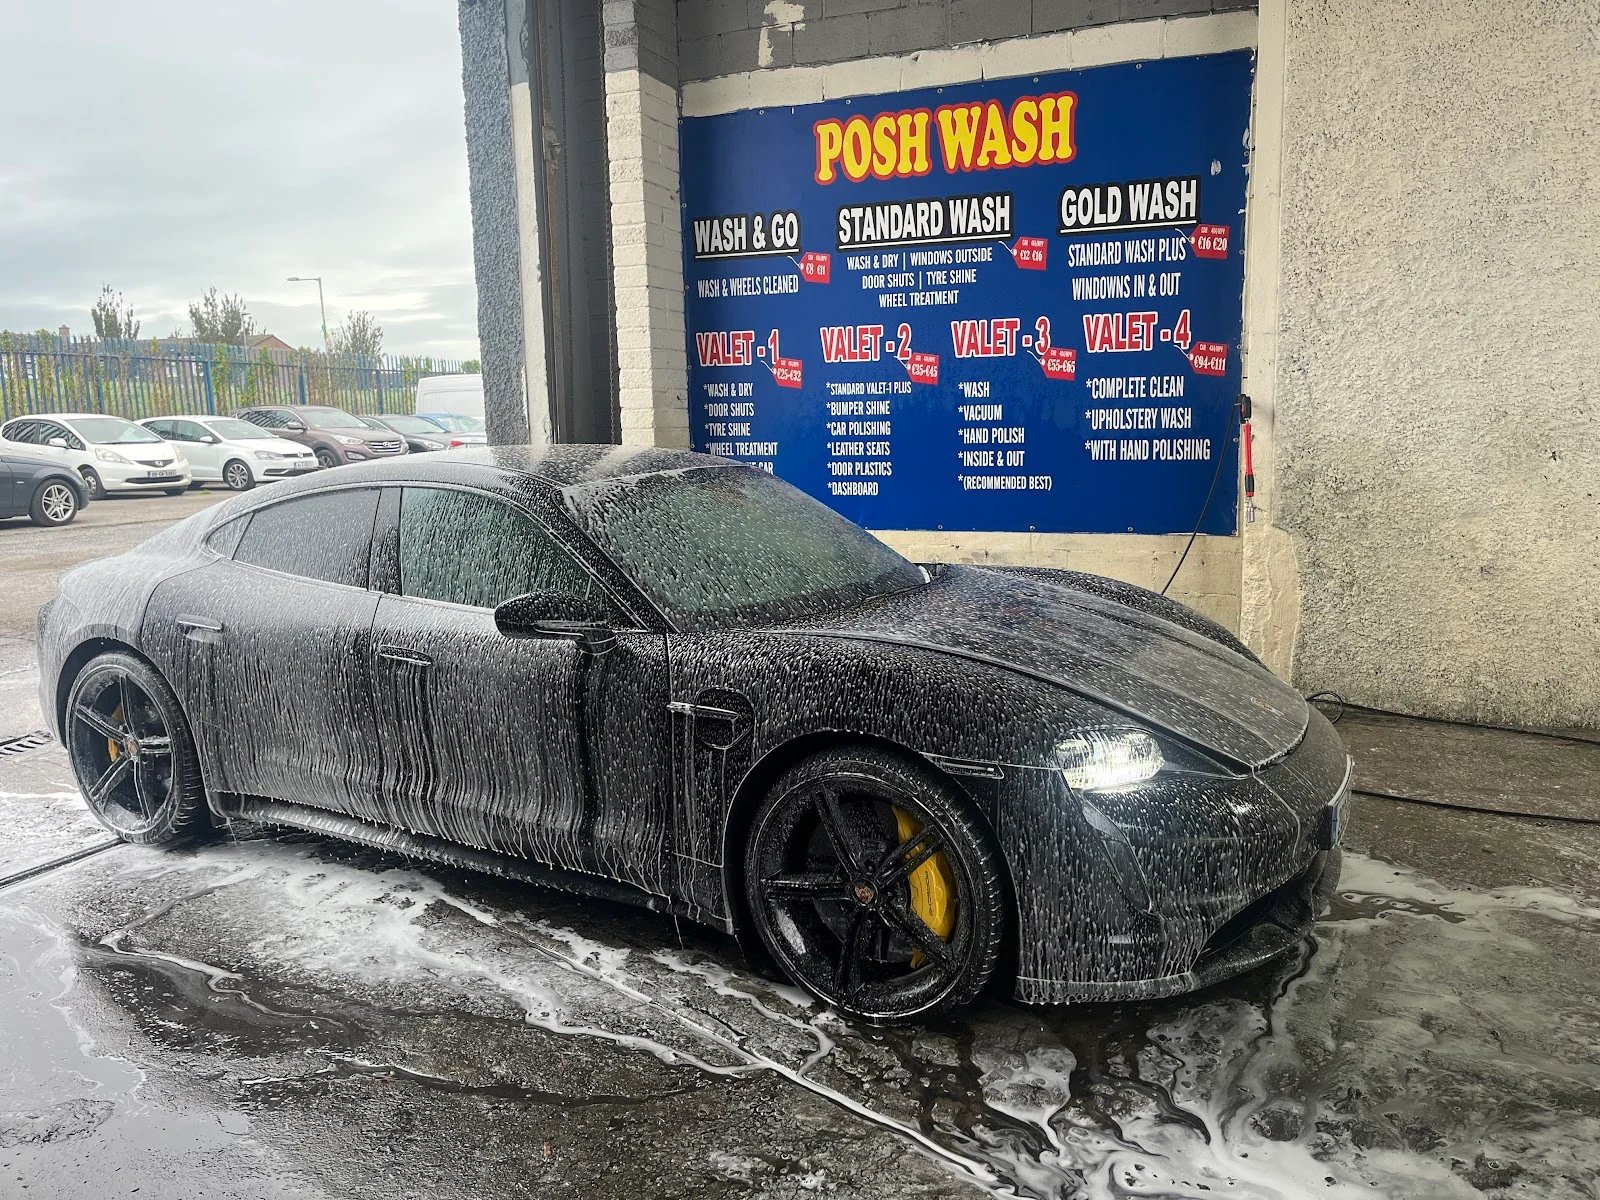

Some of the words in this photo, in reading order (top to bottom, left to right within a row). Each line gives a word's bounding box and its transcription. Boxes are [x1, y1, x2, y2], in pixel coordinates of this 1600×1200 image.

[813, 109, 931, 184] POSH
[936, 92, 1076, 171] WASH
[1061, 186, 1122, 226] GOLD
[1128, 179, 1197, 221] WASH
[839, 201, 944, 243] STANDARD
[949, 195, 1010, 235] WASH
[694, 217, 747, 253] WASH
[752, 215, 766, 249] &
[771, 212, 799, 247] GO
[1068, 241, 1120, 267] STANDARD
[1124, 239, 1155, 263] WASH
[1158, 237, 1186, 262] PLUS
[1198, 236, 1211, 250] €16
[1213, 237, 1227, 251] €20
[847, 255, 871, 270] WASH
[873, 255, 880, 269] &
[882, 254, 899, 268] DRY
[910, 251, 953, 267] WINDOWS
[955, 247, 993, 264] OUTSIDE
[1020, 249, 1030, 261] €12
[1031, 250, 1043, 262] €16
[806, 262, 814, 275] €8
[816, 264, 826, 276] €11
[697, 279, 721, 298] WASH
[721, 279, 728, 297] &
[730, 277, 761, 296] WHEELS
[763, 274, 799, 295] CLEANED
[862, 275, 885, 289] DOOR
[887, 273, 915, 288] SHUTS
[926, 270, 947, 286] TYRE
[949, 268, 977, 284] SHINE
[1072, 275, 1130, 301] WINDOWNS
[1133, 275, 1145, 297] IN
[1148, 274, 1157, 297] &
[1159, 272, 1181, 296] OUT
[879, 293, 907, 308] WHEEL
[909, 290, 959, 306] TREATMENT
[951, 318, 1020, 358] VALET
[1034, 316, 1050, 354] 3
[1083, 311, 1158, 352] VALET
[1173, 309, 1191, 349] 4
[696, 330, 755, 366] VALET
[768, 328, 779, 364] 1
[820, 325, 883, 363] VALET
[897, 323, 912, 360] 2
[911, 363, 938, 378] €35-€45
[1047, 359, 1076, 374] €55-€65
[1194, 355, 1226, 371] €94-€111
[777, 368, 801, 382] €25-€32
[731, 384, 737, 397] &
[738, 383, 753, 397] DRY
[867, 381, 892, 395] VALET-1
[894, 381, 912, 394] PLUS
[1150, 376, 1184, 397] CLEAN
[730, 402, 754, 417] SHUTS
[866, 401, 890, 415] SHINE
[1160, 408, 1192, 429] WASH
[728, 422, 751, 436] SHINE
[849, 421, 891, 436] POLISHING
[991, 427, 1025, 444] POLISH
[736, 442, 778, 456] TREATMENT
[866, 441, 891, 455] SEATS
[1120, 440, 1149, 460] HAND
[1152, 439, 1211, 461] POLISHING
[996, 451, 1004, 467] &
[1006, 450, 1025, 467] OUT
[855, 461, 892, 476] PLASTICS
[1029, 475, 1052, 491] BEST)
